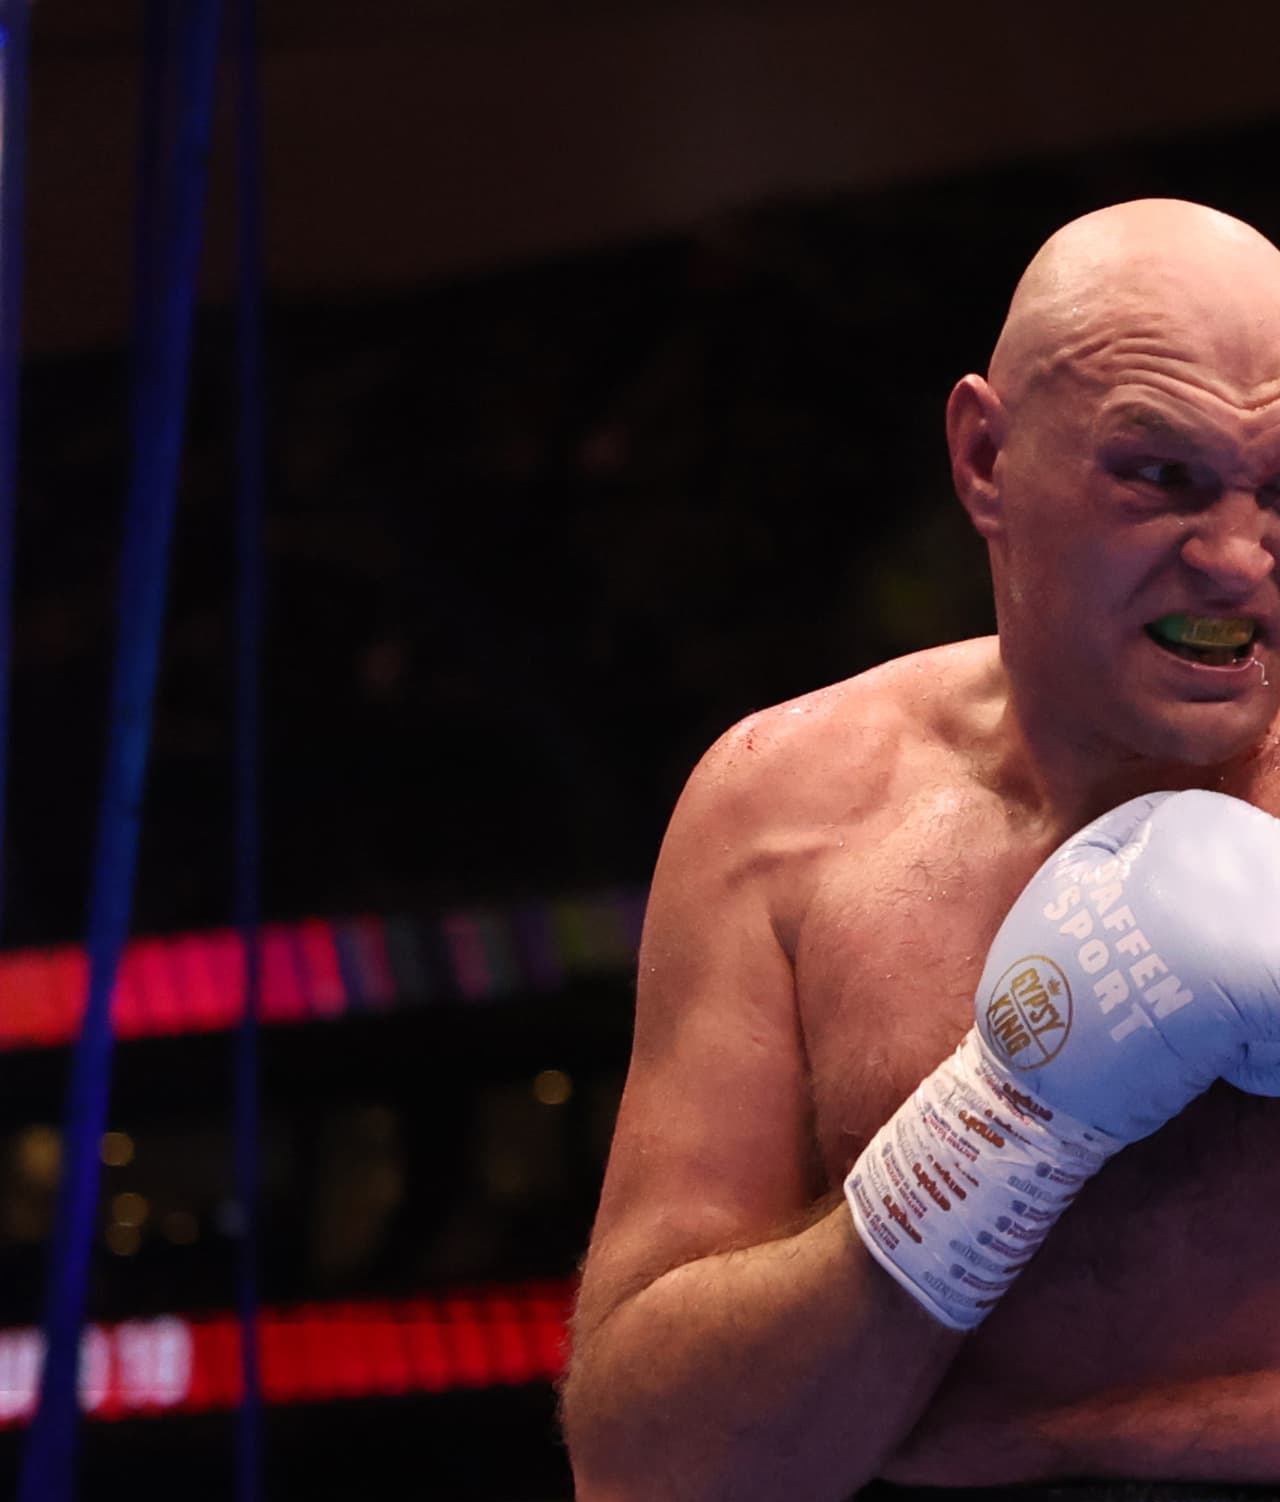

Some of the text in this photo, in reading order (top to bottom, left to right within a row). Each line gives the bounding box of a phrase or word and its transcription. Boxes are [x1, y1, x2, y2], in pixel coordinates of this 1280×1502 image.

[1043, 884, 1150, 1043] SPORT
[986, 993, 1031, 1057] KING
[1010, 967, 1066, 1036] GYPSY
